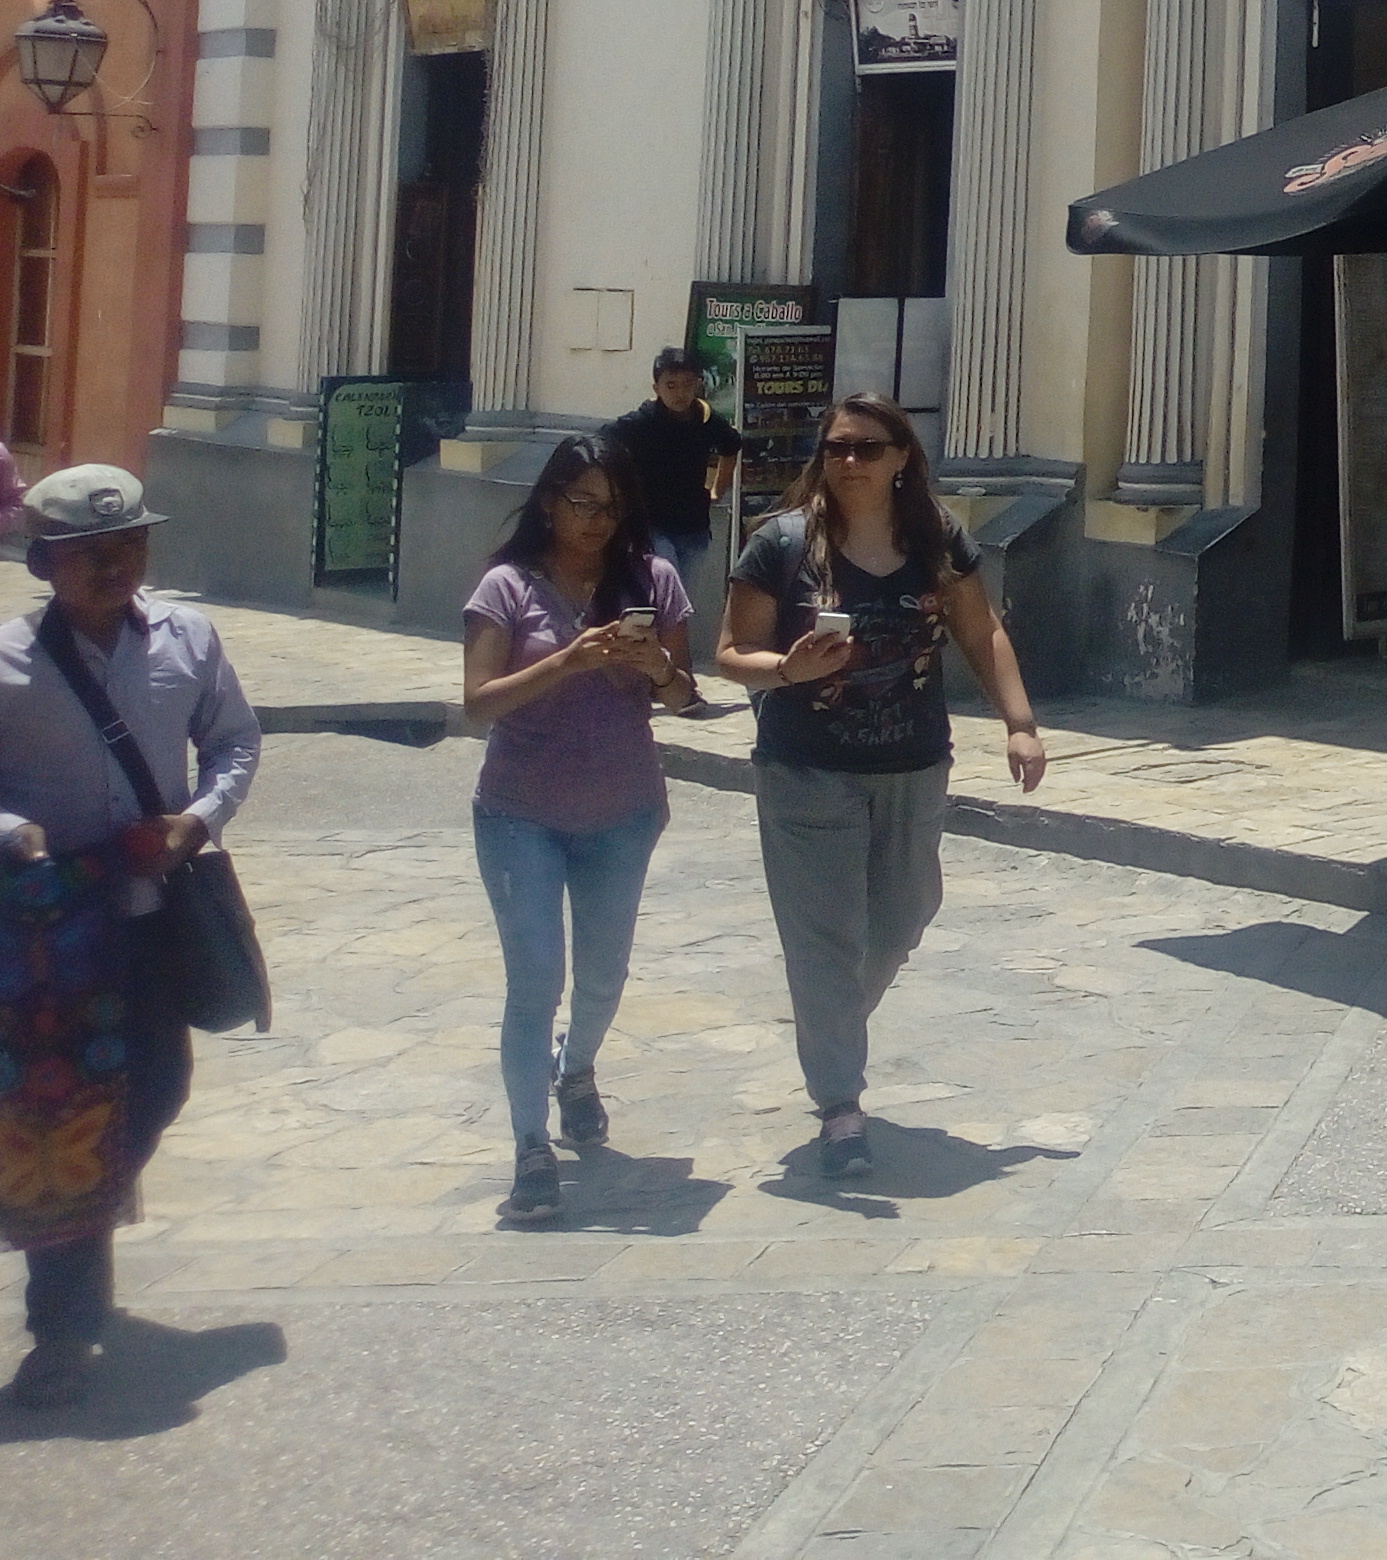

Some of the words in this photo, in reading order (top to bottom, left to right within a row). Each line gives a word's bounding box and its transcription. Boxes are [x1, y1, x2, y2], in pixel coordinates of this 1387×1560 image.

[706, 298, 742, 320] Tours
[743, 303, 753, 321] a
[754, 300, 803, 322] Caballo
[756, 380, 804, 395] TOURS
